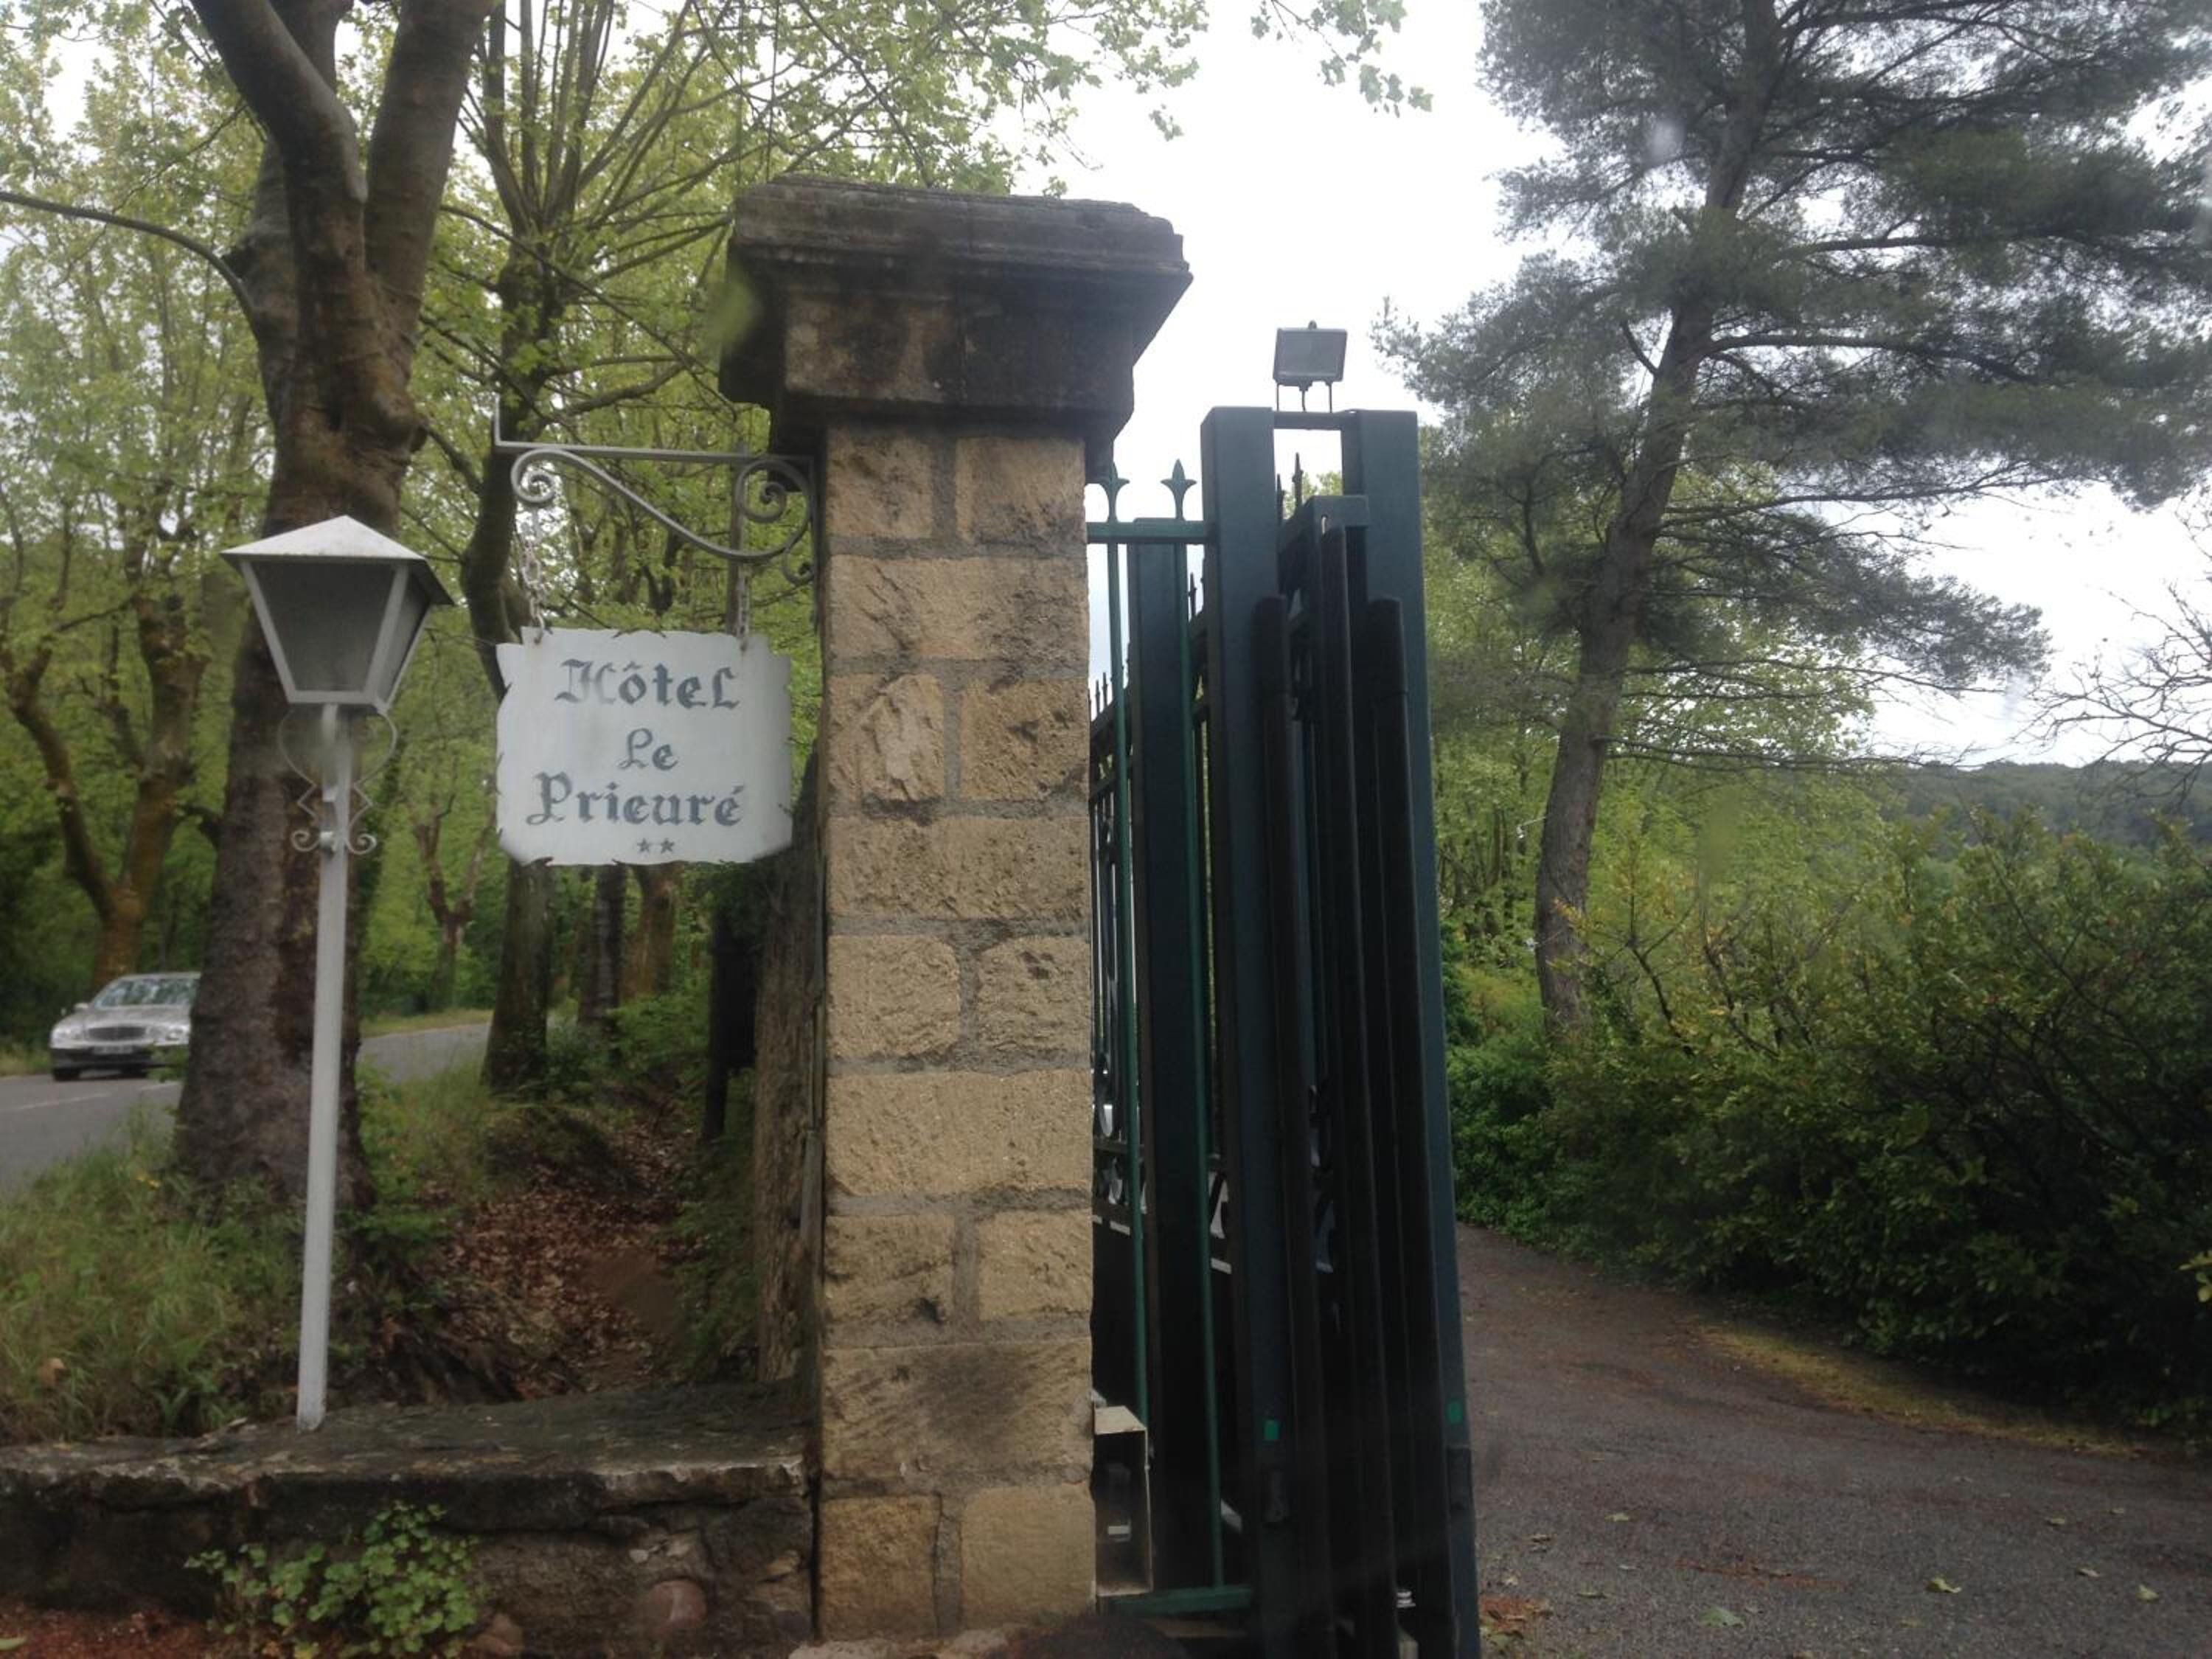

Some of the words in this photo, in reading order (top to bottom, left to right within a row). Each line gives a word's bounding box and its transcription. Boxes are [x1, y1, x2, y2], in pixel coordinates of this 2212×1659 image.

[554, 658, 740, 709] Hôtel
[618, 727, 678, 771] Le
[526, 771, 745, 827] Prieuré
